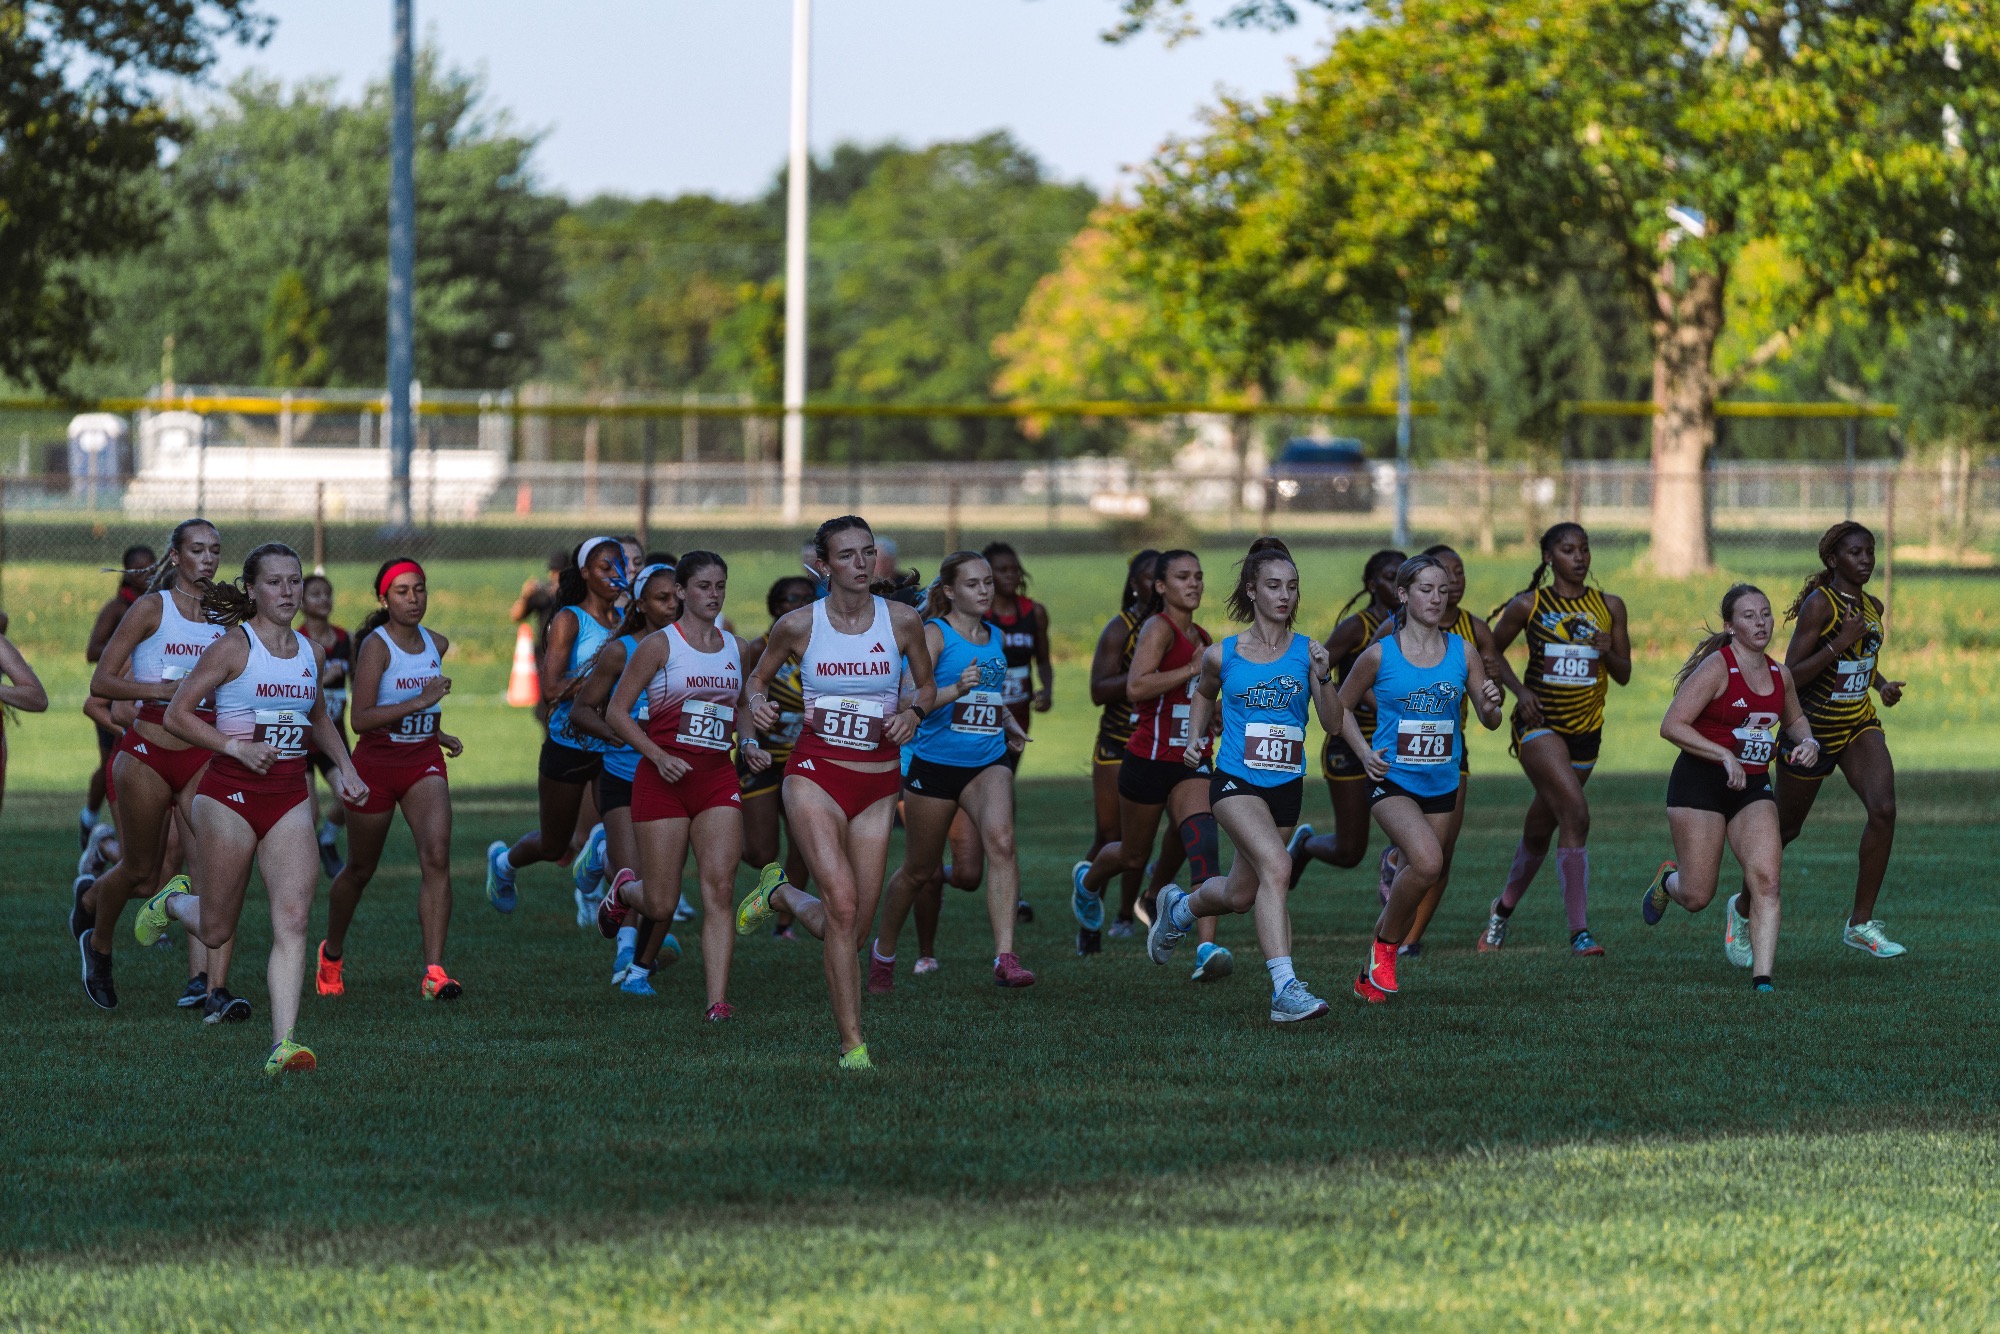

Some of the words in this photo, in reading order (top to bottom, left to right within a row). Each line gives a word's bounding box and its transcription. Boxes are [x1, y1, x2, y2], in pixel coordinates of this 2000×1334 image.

[164, 643, 206, 656] MONTC
[815, 661, 891, 676] MONTCLAIR
[1552, 657, 1590, 677] 496
[686, 676, 739, 690] MONTCLAIR
[1842, 670, 1871, 692] 494
[841, 701, 860, 710] PSAC
[1245, 687, 1293, 711] HFU
[1405, 692, 1450, 715] HFU
[401, 714, 434, 734] 518
[823, 711, 870, 739] 515
[962, 704, 997, 726] 479
[263, 726, 304, 749] 522
[688, 714, 725, 741] 520
[1255, 739, 1293, 762] 481
[1407, 735, 1445, 755] 478
[1741, 740, 1772, 762] 533
